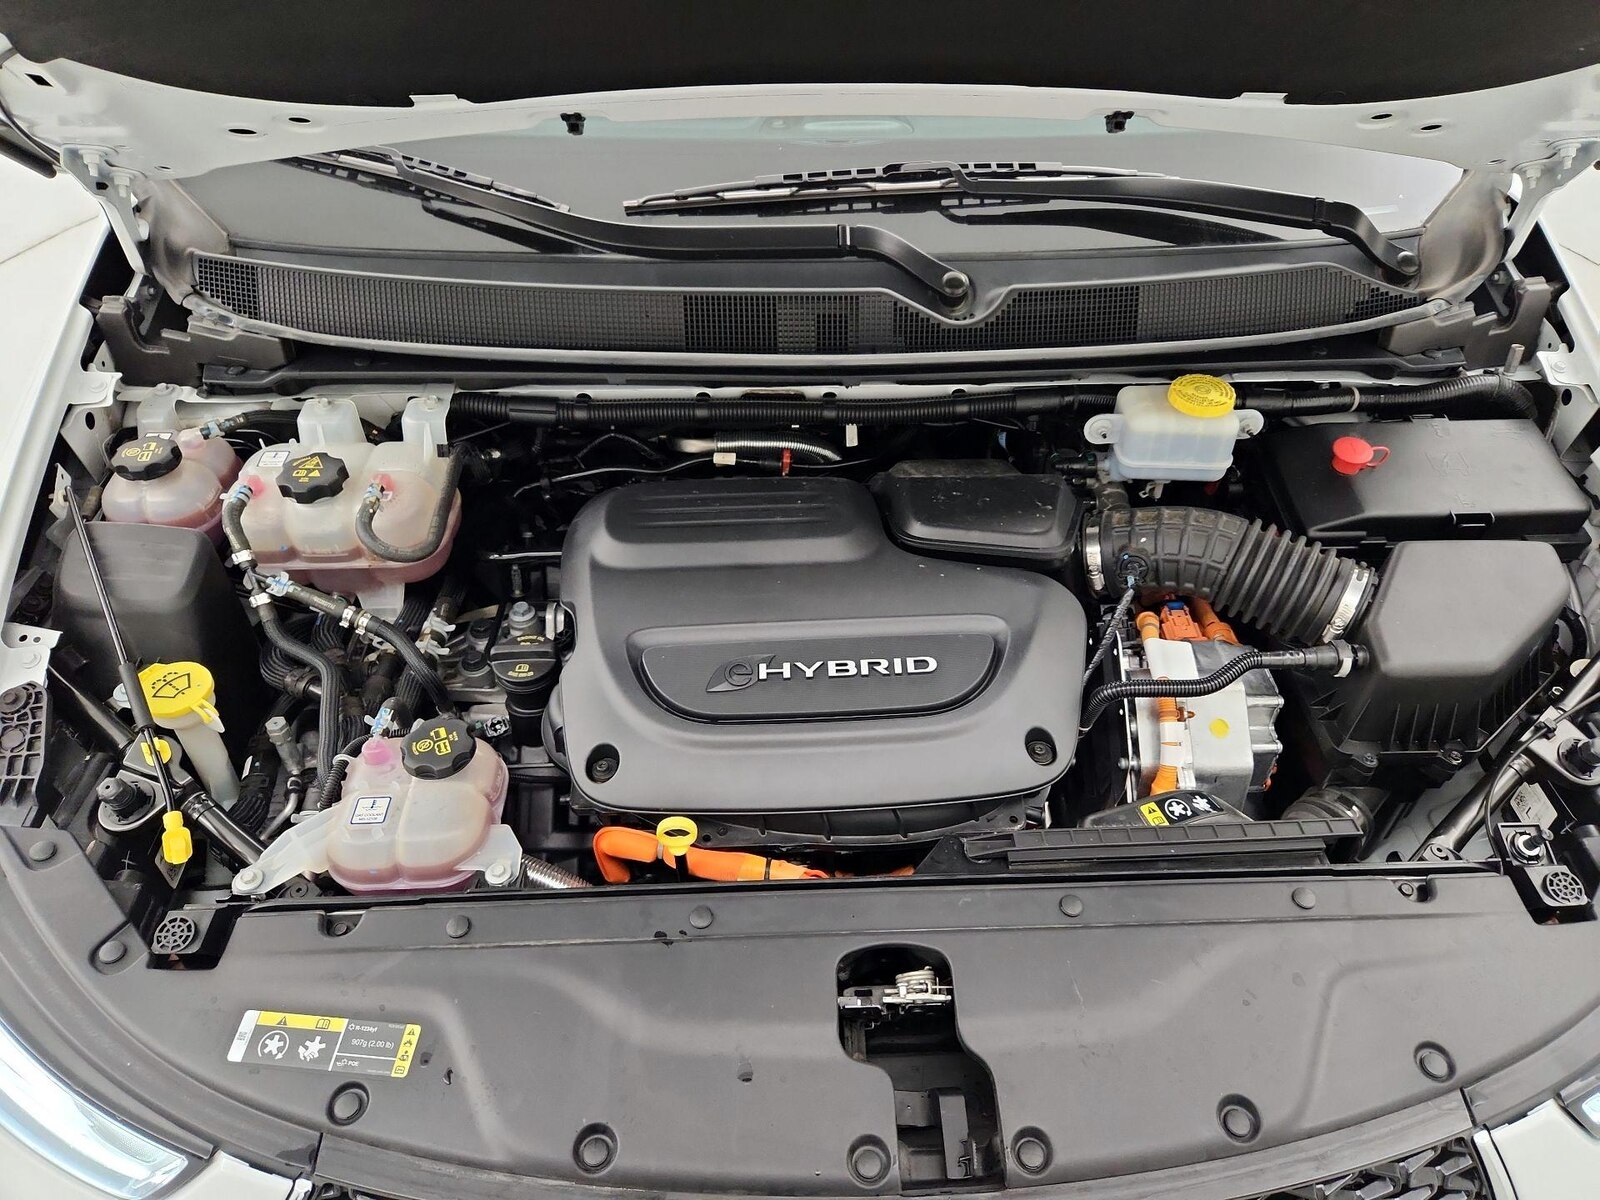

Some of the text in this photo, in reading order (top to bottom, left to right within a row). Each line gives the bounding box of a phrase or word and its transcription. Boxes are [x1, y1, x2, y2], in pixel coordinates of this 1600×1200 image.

[354, 1025, 378, 1033] R-1234yf
[351, 1038, 394, 1050] 907g (2.00 lb)
